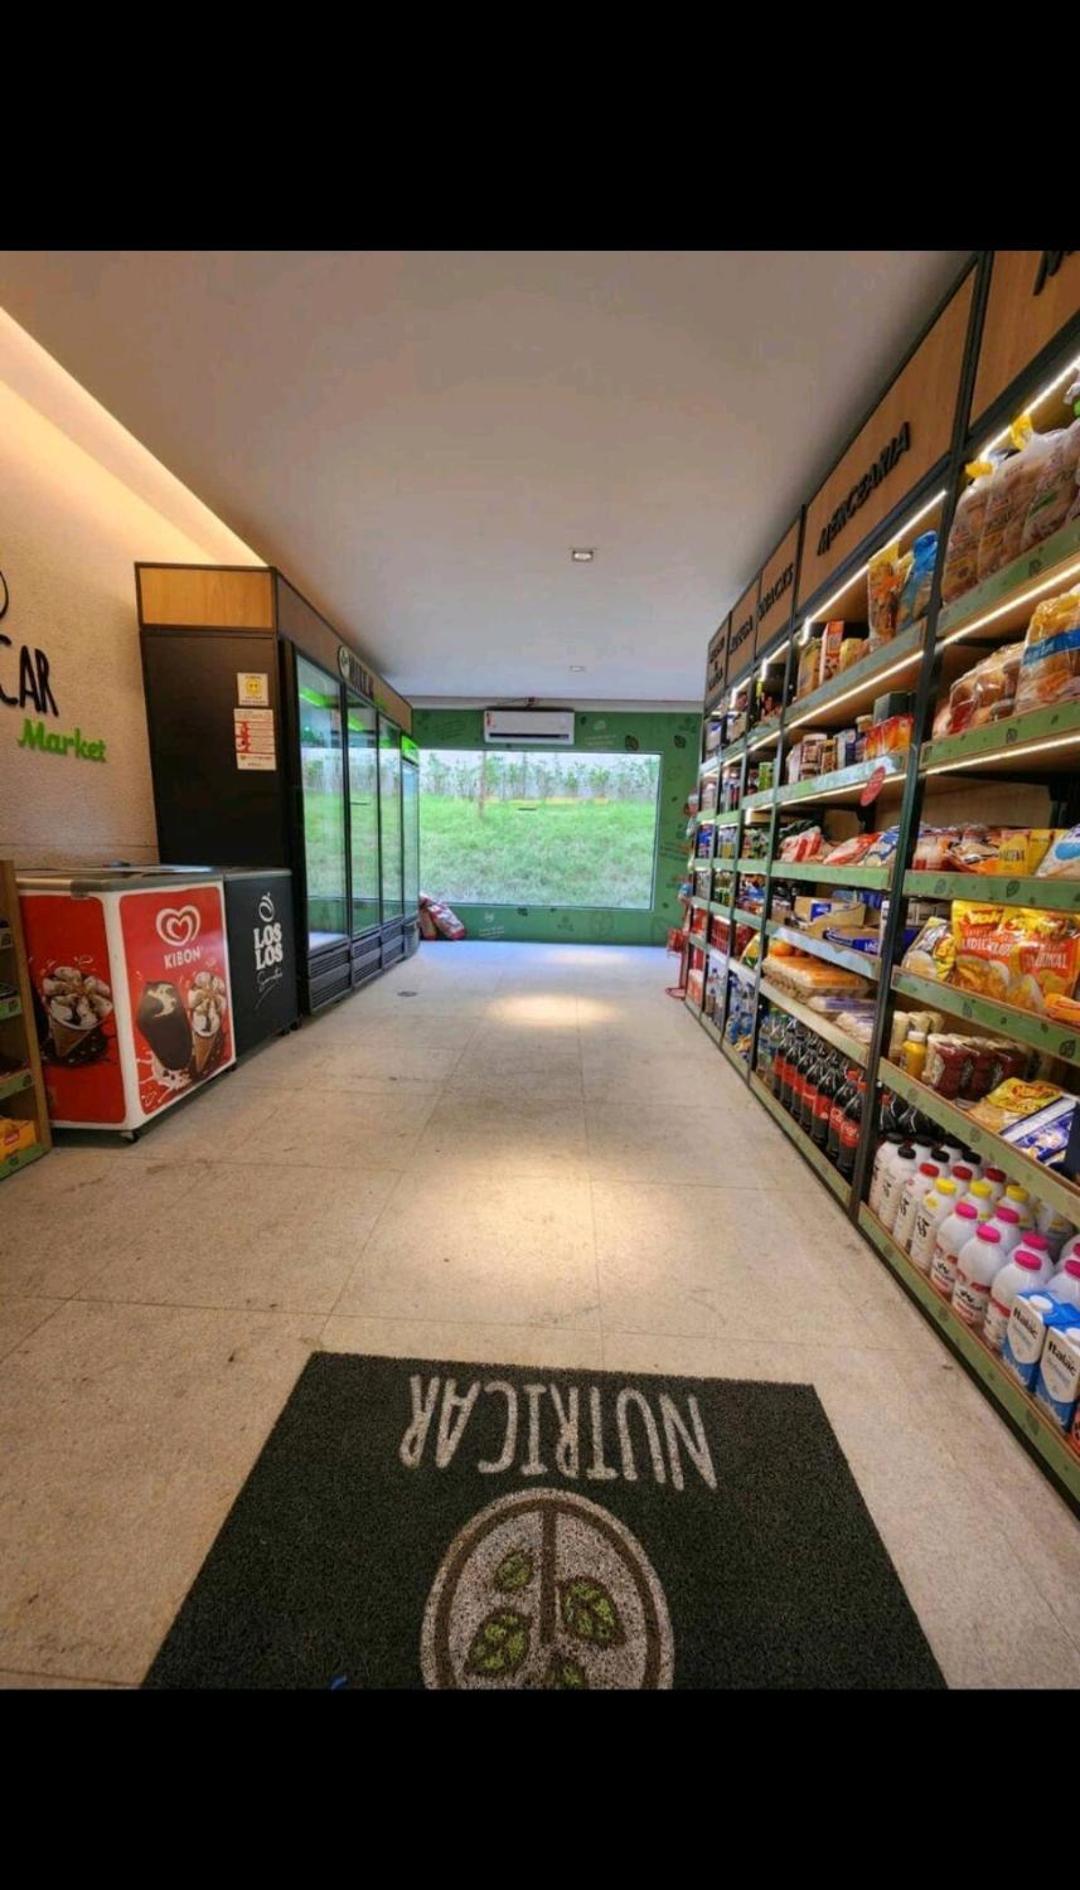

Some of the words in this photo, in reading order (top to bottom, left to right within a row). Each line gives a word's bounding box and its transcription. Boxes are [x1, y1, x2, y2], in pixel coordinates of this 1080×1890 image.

[17, 718, 107, 764] Market
[253, 922, 282, 949] LOS
[164, 945, 201, 971] KIBON
[256, 943, 284, 970] LOS
[400, 1374, 718, 1492] NUTRICAR
